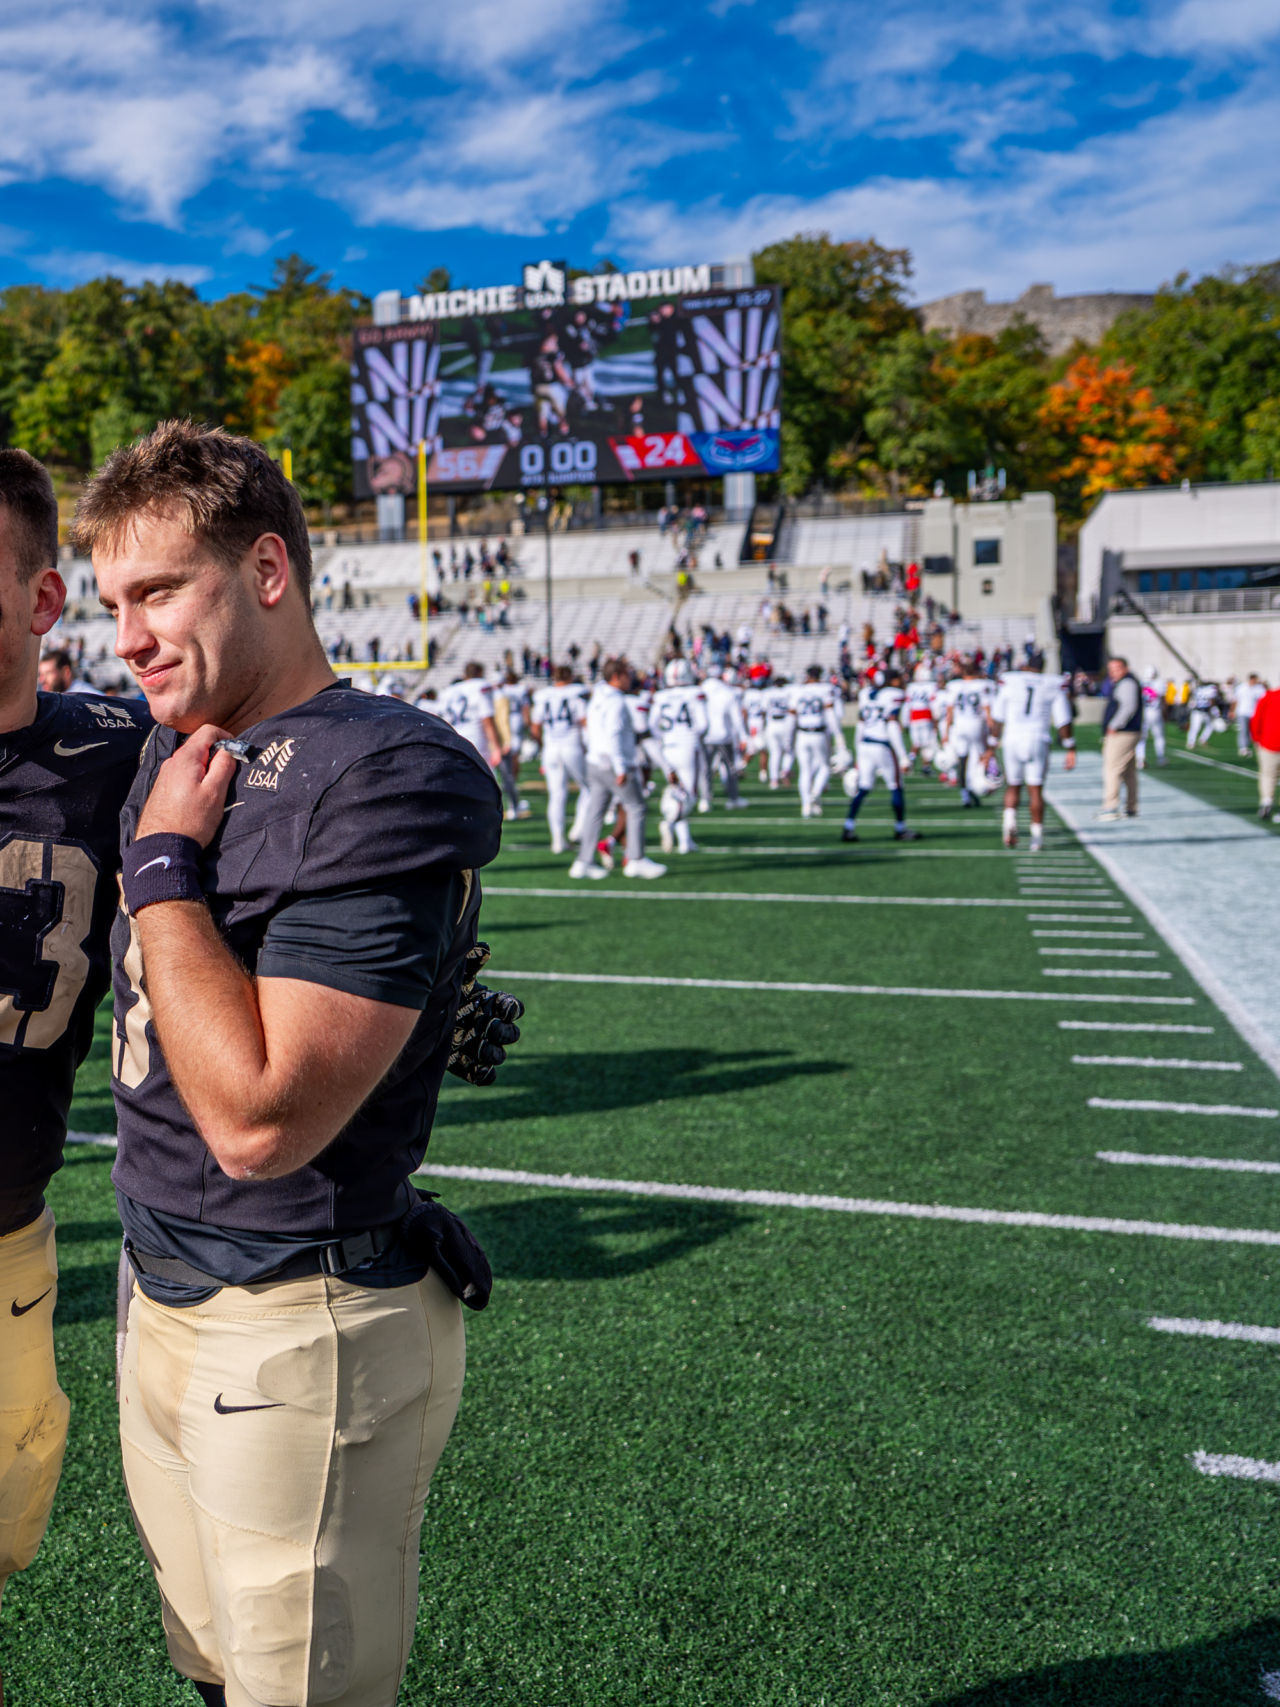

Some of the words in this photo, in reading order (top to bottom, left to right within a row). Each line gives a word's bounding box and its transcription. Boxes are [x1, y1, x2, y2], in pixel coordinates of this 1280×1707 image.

[409, 284, 517, 322] MICHIE
[573, 264, 711, 304] STADIUM
[437, 449, 479, 480] 56
[644, 435, 686, 468] 24
[542, 699, 573, 727] 44
[1023, 686, 1033, 714] 1
[96, 717, 137, 729] USAA
[660, 703, 693, 730] 54
[246, 768, 279, 790] USAA
